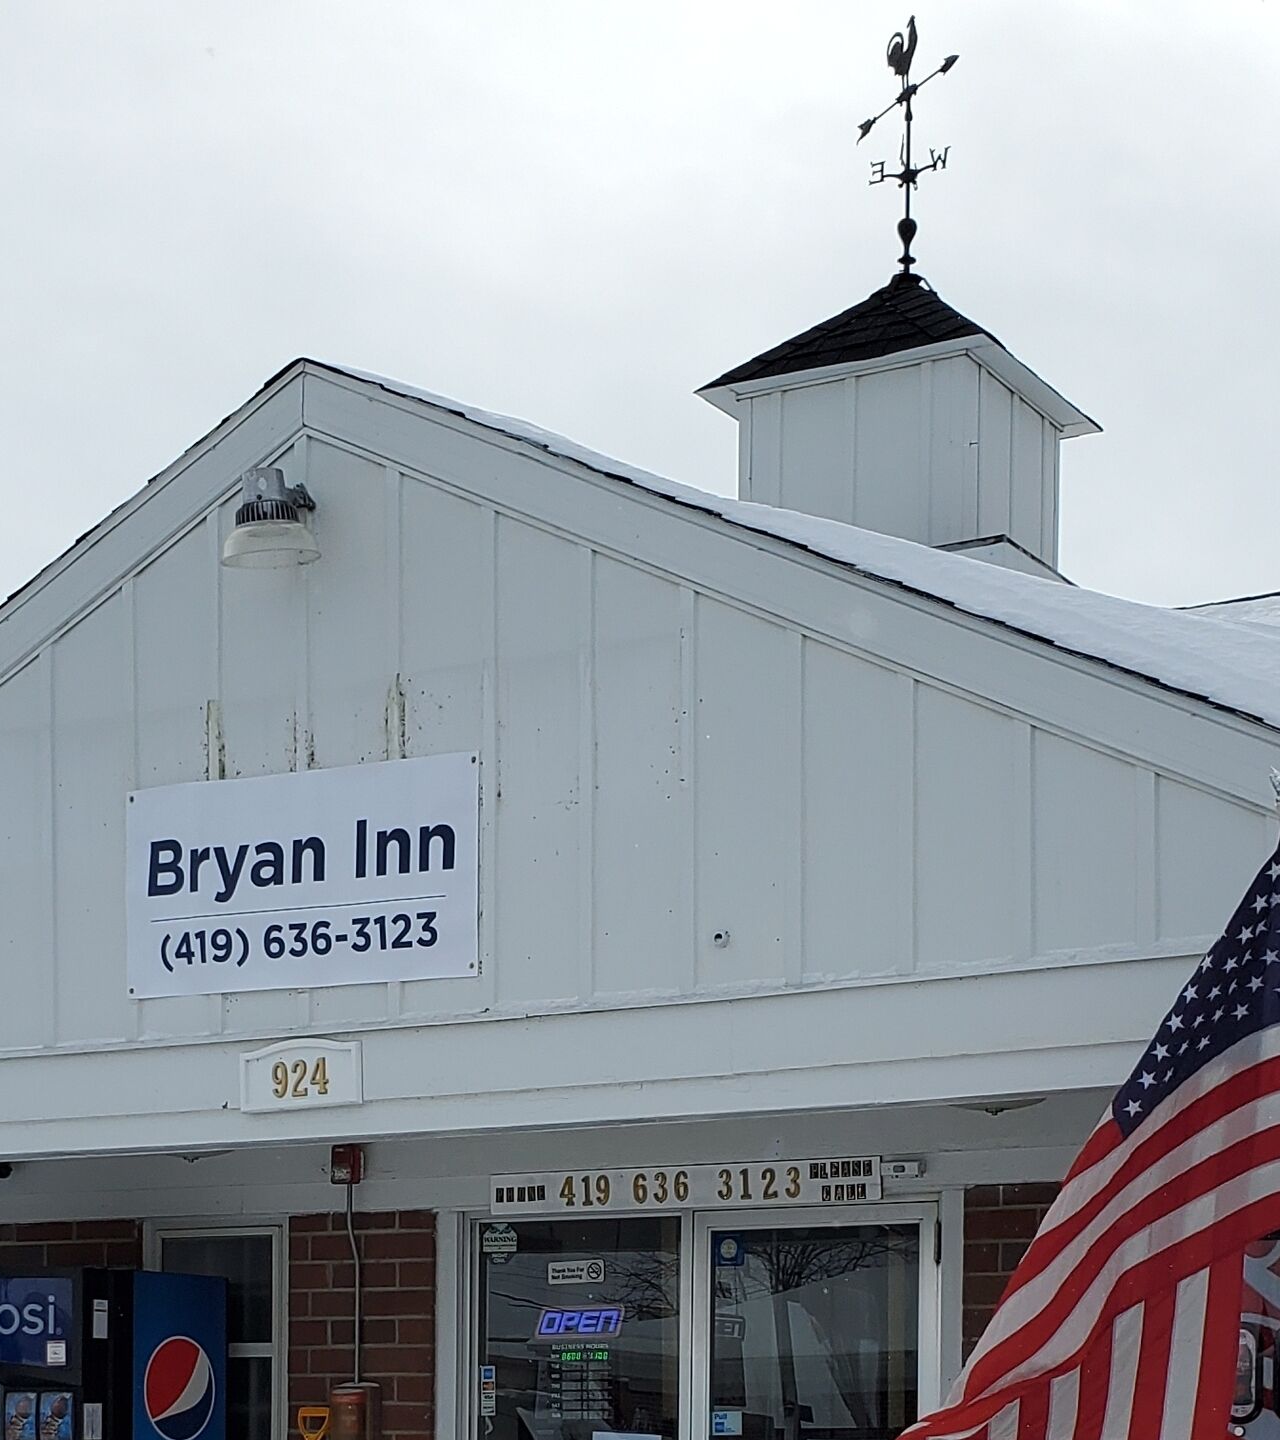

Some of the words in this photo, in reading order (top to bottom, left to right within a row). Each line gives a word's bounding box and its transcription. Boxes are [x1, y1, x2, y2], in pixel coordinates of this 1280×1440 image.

[147, 836, 326, 903] Bryan
[355, 819, 456, 879] Inn
[160, 928, 250, 972] (419)
[263, 911, 439, 960] 636-3123
[271, 1056, 330, 1099] 924
[495, 1185, 546, 1203] PHONE
[559, 1174, 611, 1207] 419
[632, 1170, 689, 1205] 636
[717, 1166, 802, 1201] 3123
[809, 1160, 873, 1180] PLEASE
[822, 1183, 867, 1201] CALL
[483, 1235, 517, 1244] WARNING
[540, 1309, 619, 1334] OPEN
